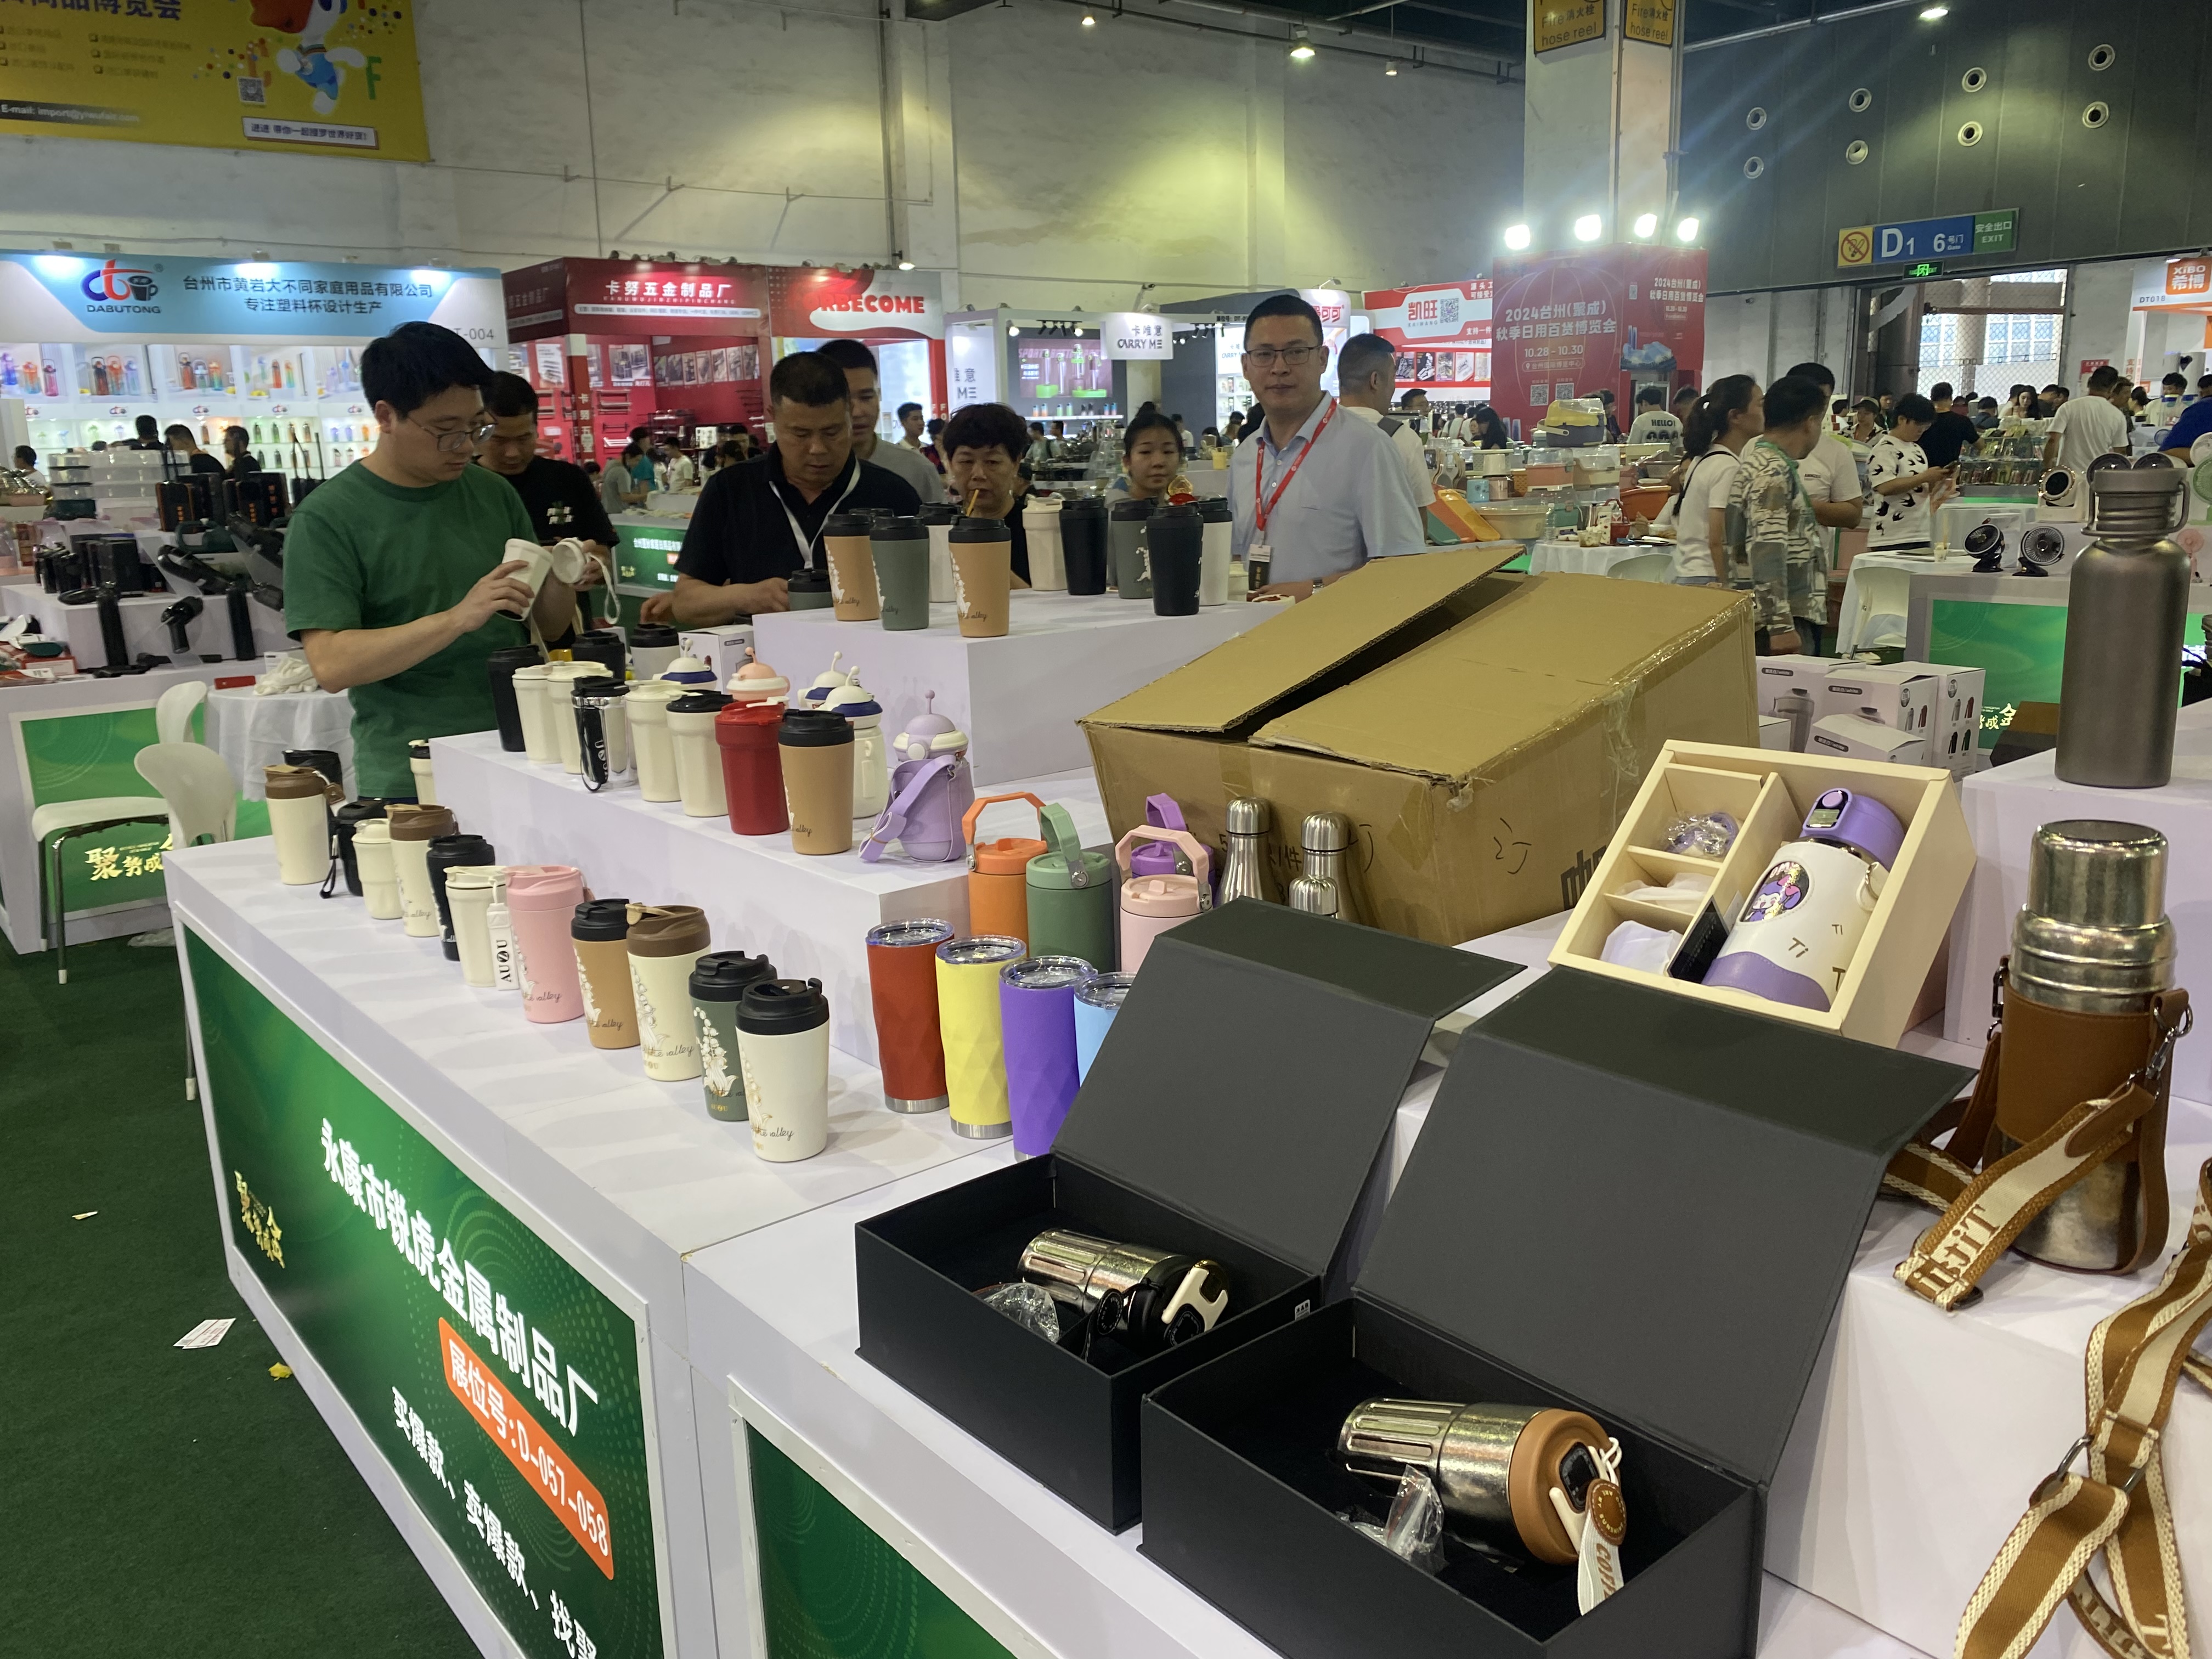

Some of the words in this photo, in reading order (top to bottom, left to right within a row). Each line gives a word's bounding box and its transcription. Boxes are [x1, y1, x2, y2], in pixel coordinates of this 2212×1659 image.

[1632, 4, 1648, 18] Fire
[1542, 14, 1564, 29] Fire
[1542, 31, 1570, 47] hose
[1573, 23, 1597, 39] reel
[1630, 22, 1651, 36] hose
[1652, 28, 1668, 41] reel
[1975, 221, 2012, 233] 安全出口
[1933, 233, 1946, 252] 6
[1982, 234, 2004, 243] EXIT
[183, 276, 433, 298] 台州市黄岩大不同家庭用品有限公司
[2171, 273, 2205, 290] 希博
[605, 280, 732, 298] 卡努五金制品厂
[1650, 289, 1704, 303] 秋季日用百货博览会
[244, 297, 383, 315] 专注塑料杯设计生产
[2139, 295, 2165, 303] DT018
[86, 304, 161, 314] DABUTONG
[1408, 300, 1438, 321] 凯旺
[1408, 319, 1438, 328] KAIWANG
[1496, 318, 1617, 341] 秋季日用百货博览会
[1117, 339, 1147, 349] CARRY
[1524, 347, 1549, 358] 10.28
[1558, 345, 1584, 356] 10.30
[1651, 419, 1676, 427] HELLO!
[1788, 937, 1809, 958] Ti
[536, 991, 562, 1003] valley
[666, 1044, 695, 1057] valley
[769, 1127, 794, 1141] valley
[321, 1118, 599, 1436] 永康市锐虎金属制品厂
